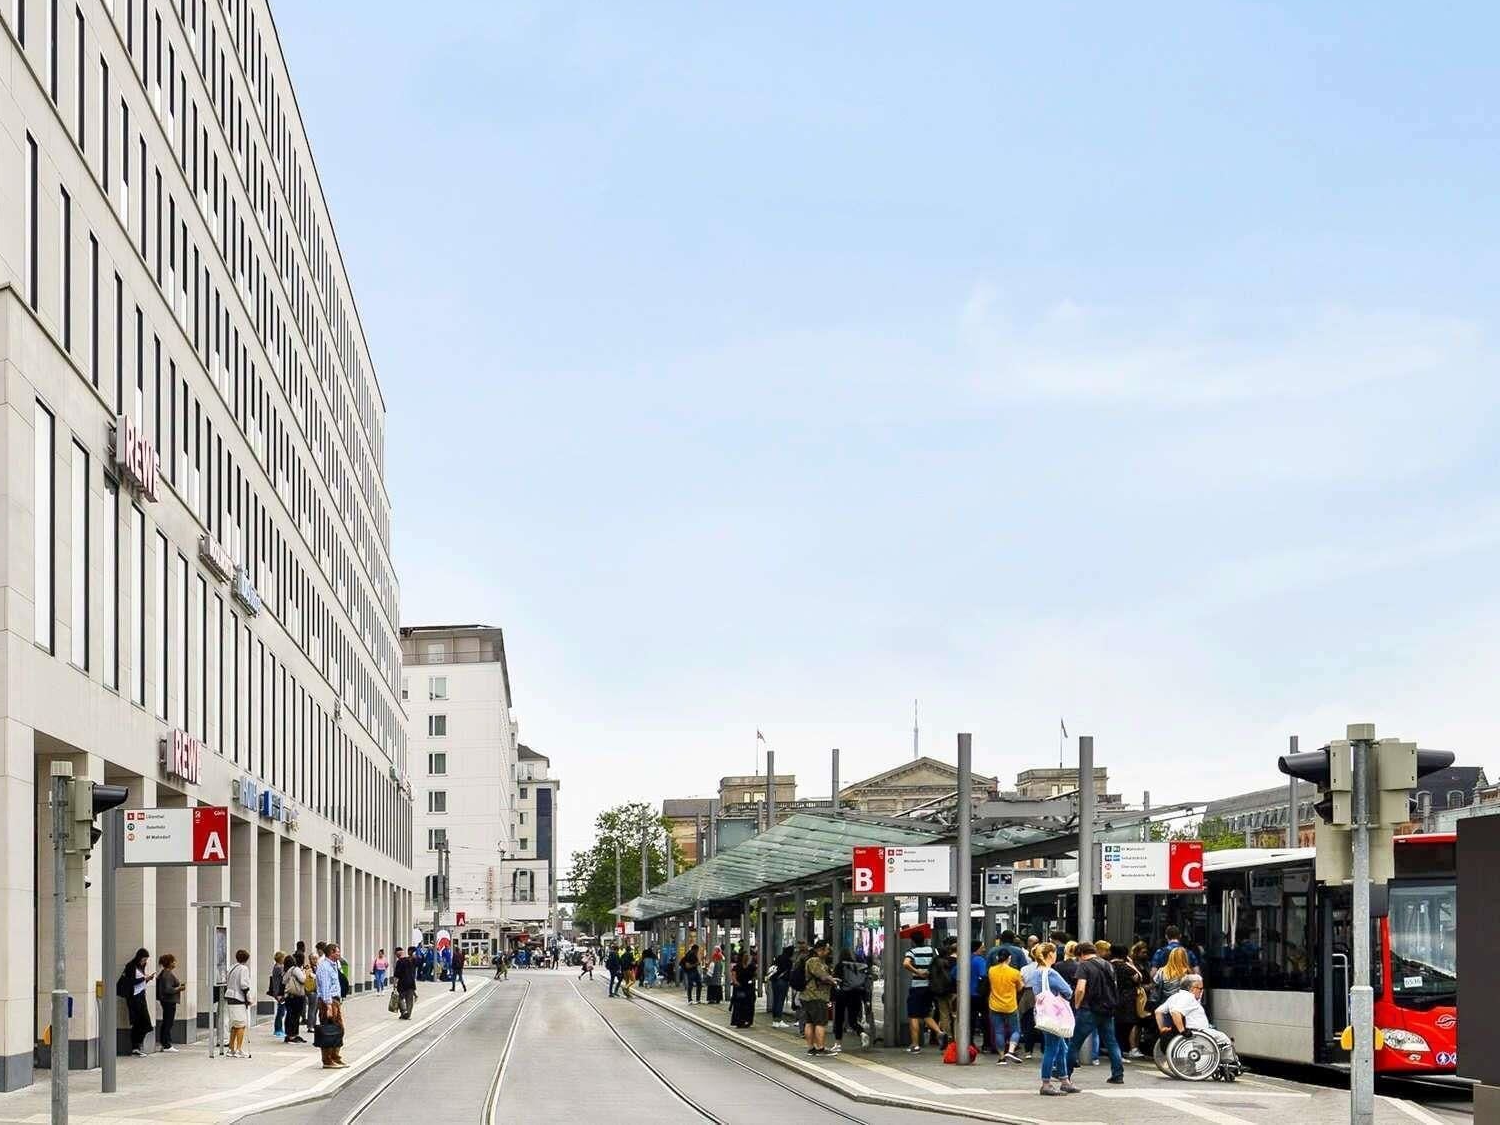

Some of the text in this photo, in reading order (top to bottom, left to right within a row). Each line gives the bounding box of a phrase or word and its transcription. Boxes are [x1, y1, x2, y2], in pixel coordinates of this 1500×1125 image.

[124, 415, 161, 502] REWE
[173, 729, 202, 785] REWE
[202, 831, 226, 859] A
[854, 868, 874, 892] B
[1181, 862, 1202, 888] C
[458, 917, 466, 926] A
